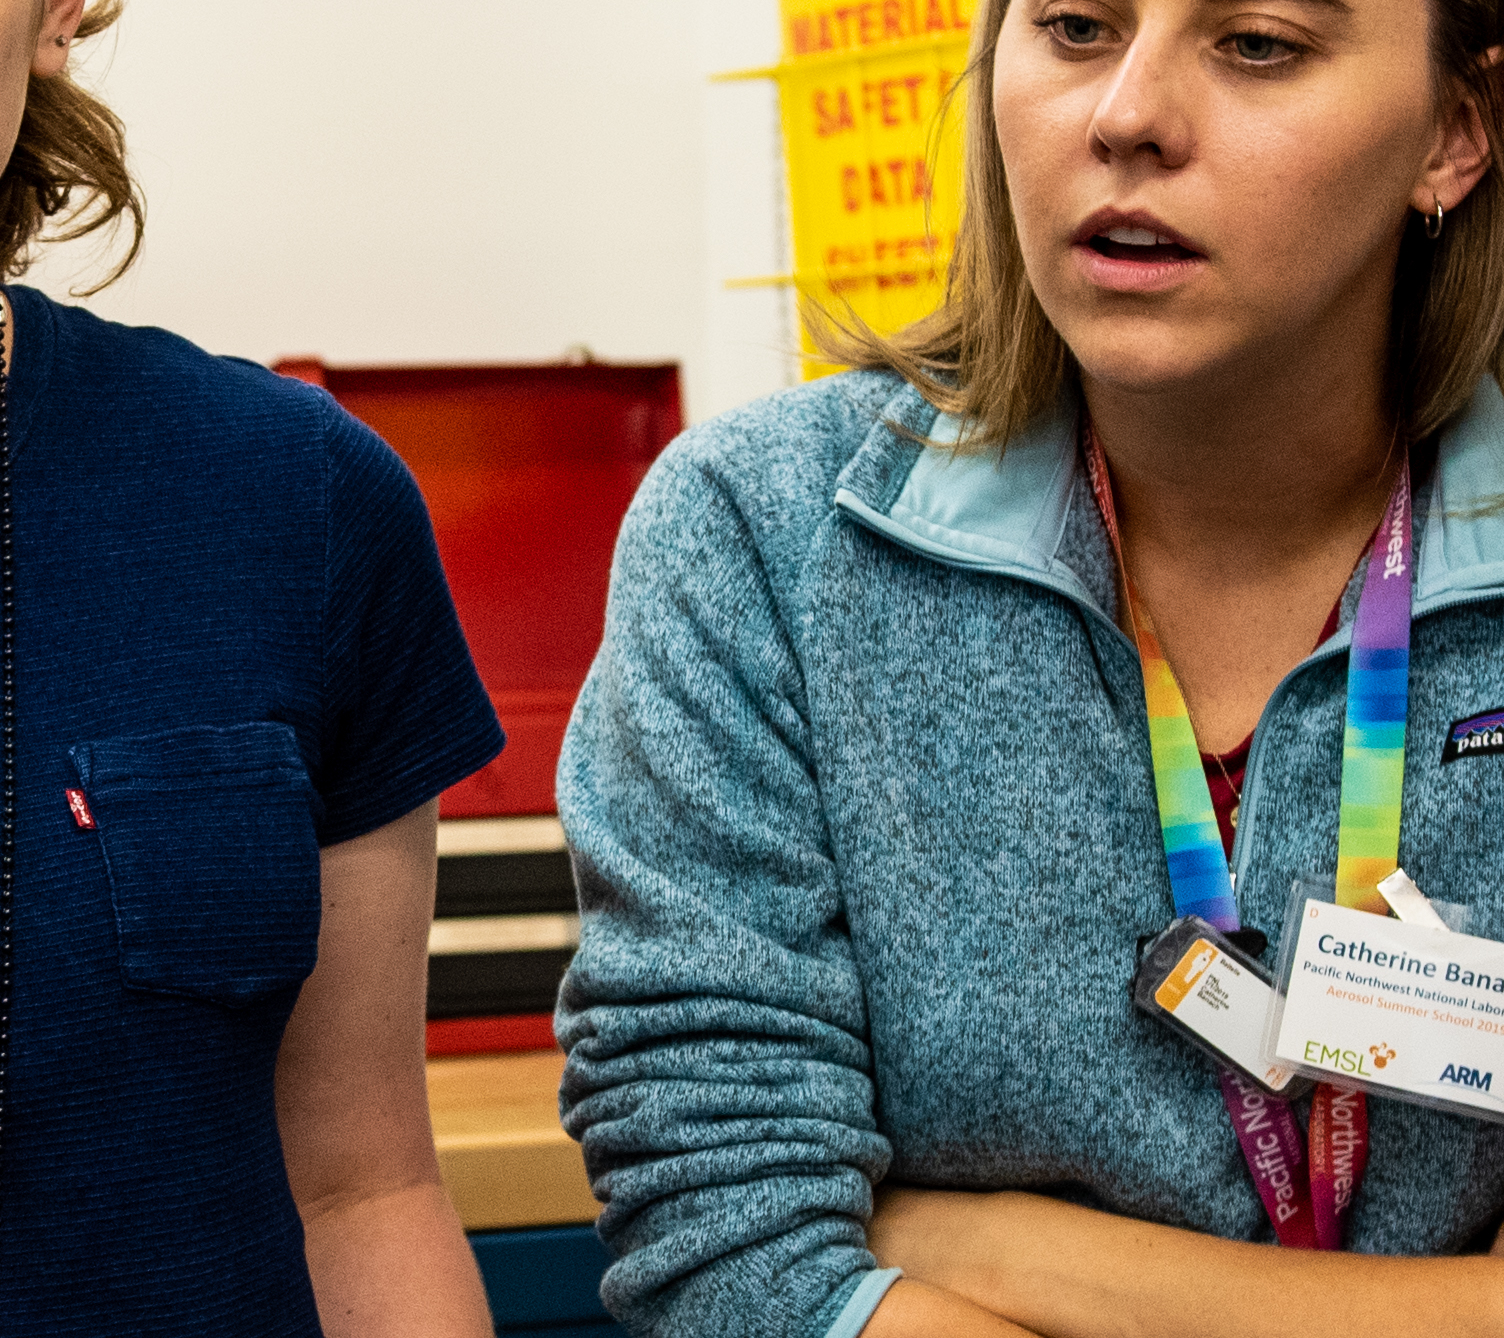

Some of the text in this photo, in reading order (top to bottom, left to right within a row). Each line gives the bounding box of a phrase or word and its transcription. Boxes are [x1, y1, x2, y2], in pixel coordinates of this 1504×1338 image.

[1317, 934, 1437, 979] Catherine
[1303, 961, 1342, 981] Pacific
[1345, 971, 1411, 996] Northwest
[1414, 986, 1468, 1009] National
[1326, 984, 1374, 1006] Aerosol
[1376, 996, 1429, 1018] Summer
[1432, 1008, 1474, 1029] School
[1304, 1041, 1371, 1077] EMSL
[1438, 1063, 1493, 1092] ARM
[1253, 1133, 1299, 1224] Pacific
